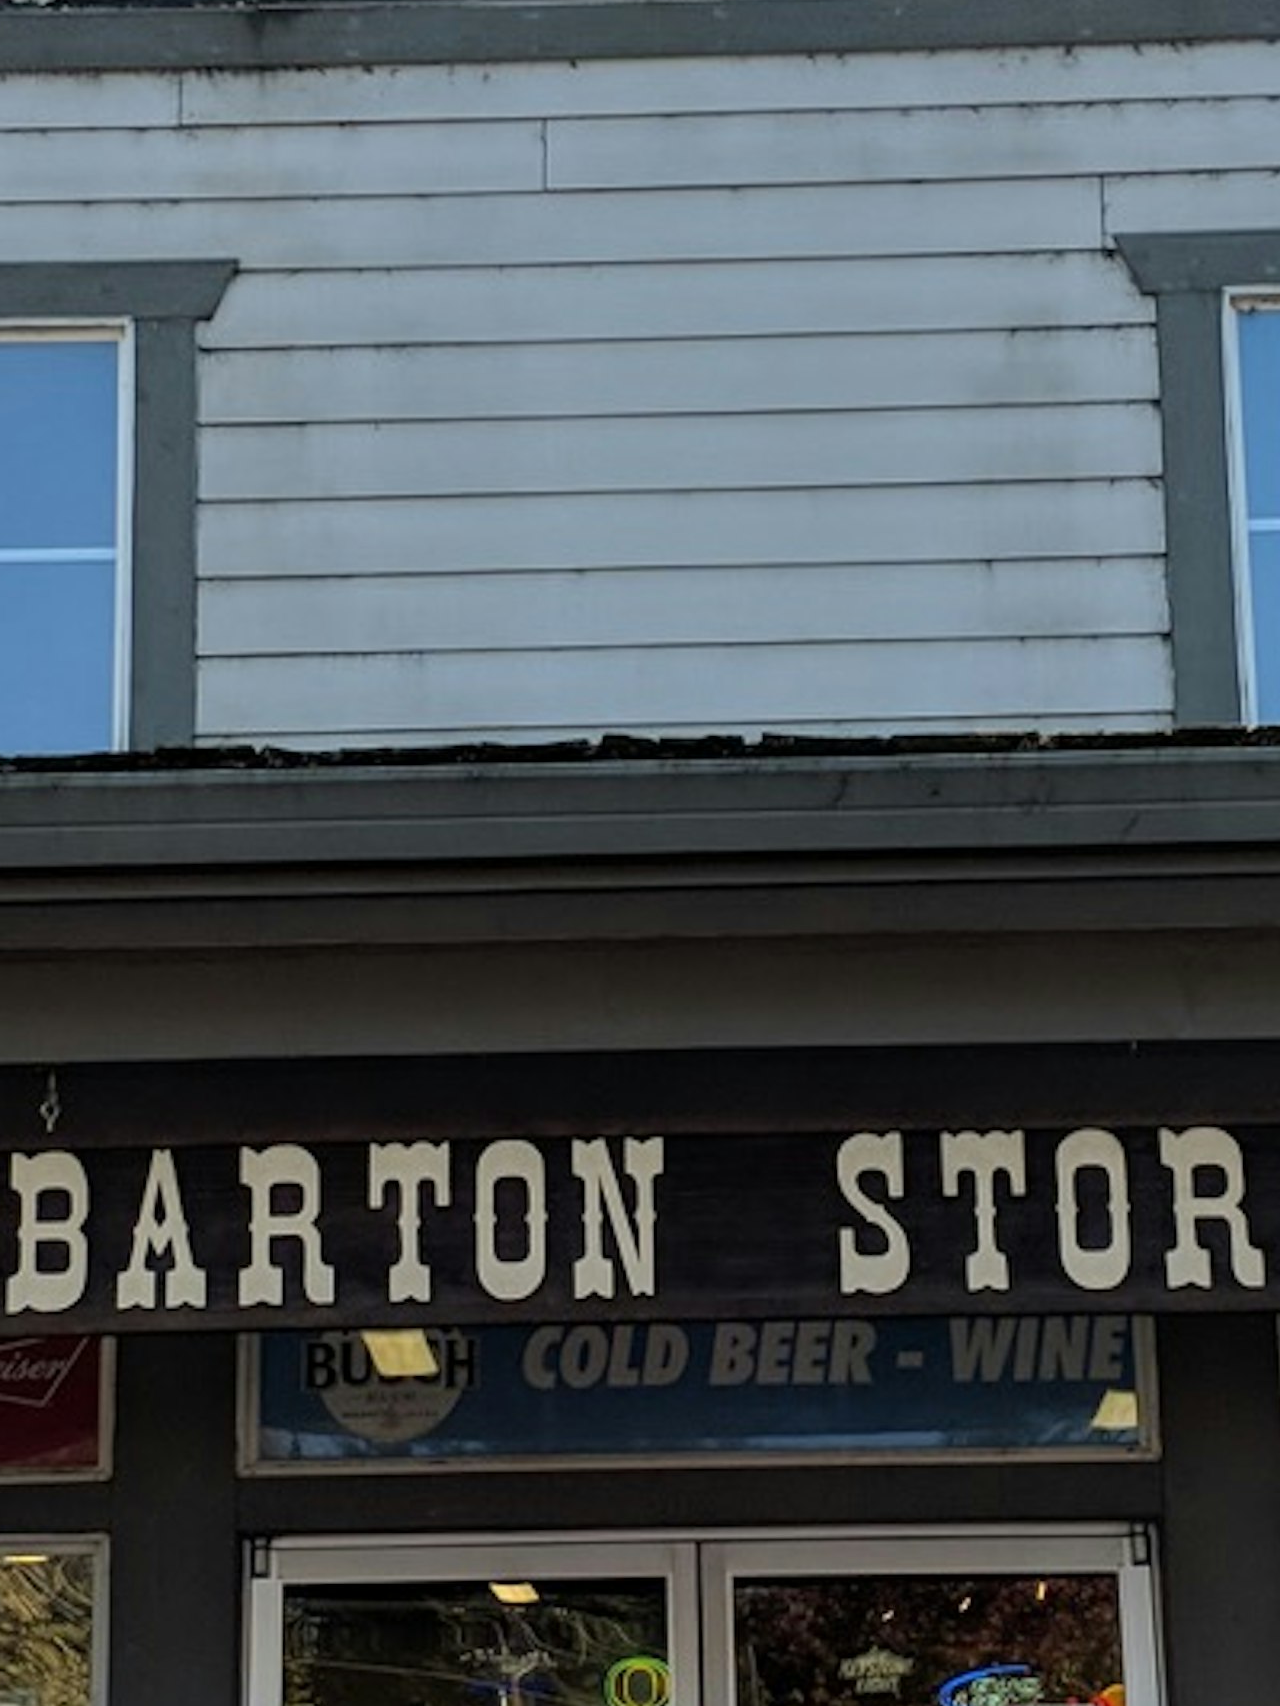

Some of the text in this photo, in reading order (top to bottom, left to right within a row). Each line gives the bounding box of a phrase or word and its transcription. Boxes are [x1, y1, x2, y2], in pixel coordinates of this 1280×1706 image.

[4, 1135, 665, 1314] BARTON
[305, 1338, 476, 1389] BUH
[522, 1324, 690, 1390] COLD
[708, 1319, 880, 1386] BEER
[947, 1314, 1131, 1383] WINE
